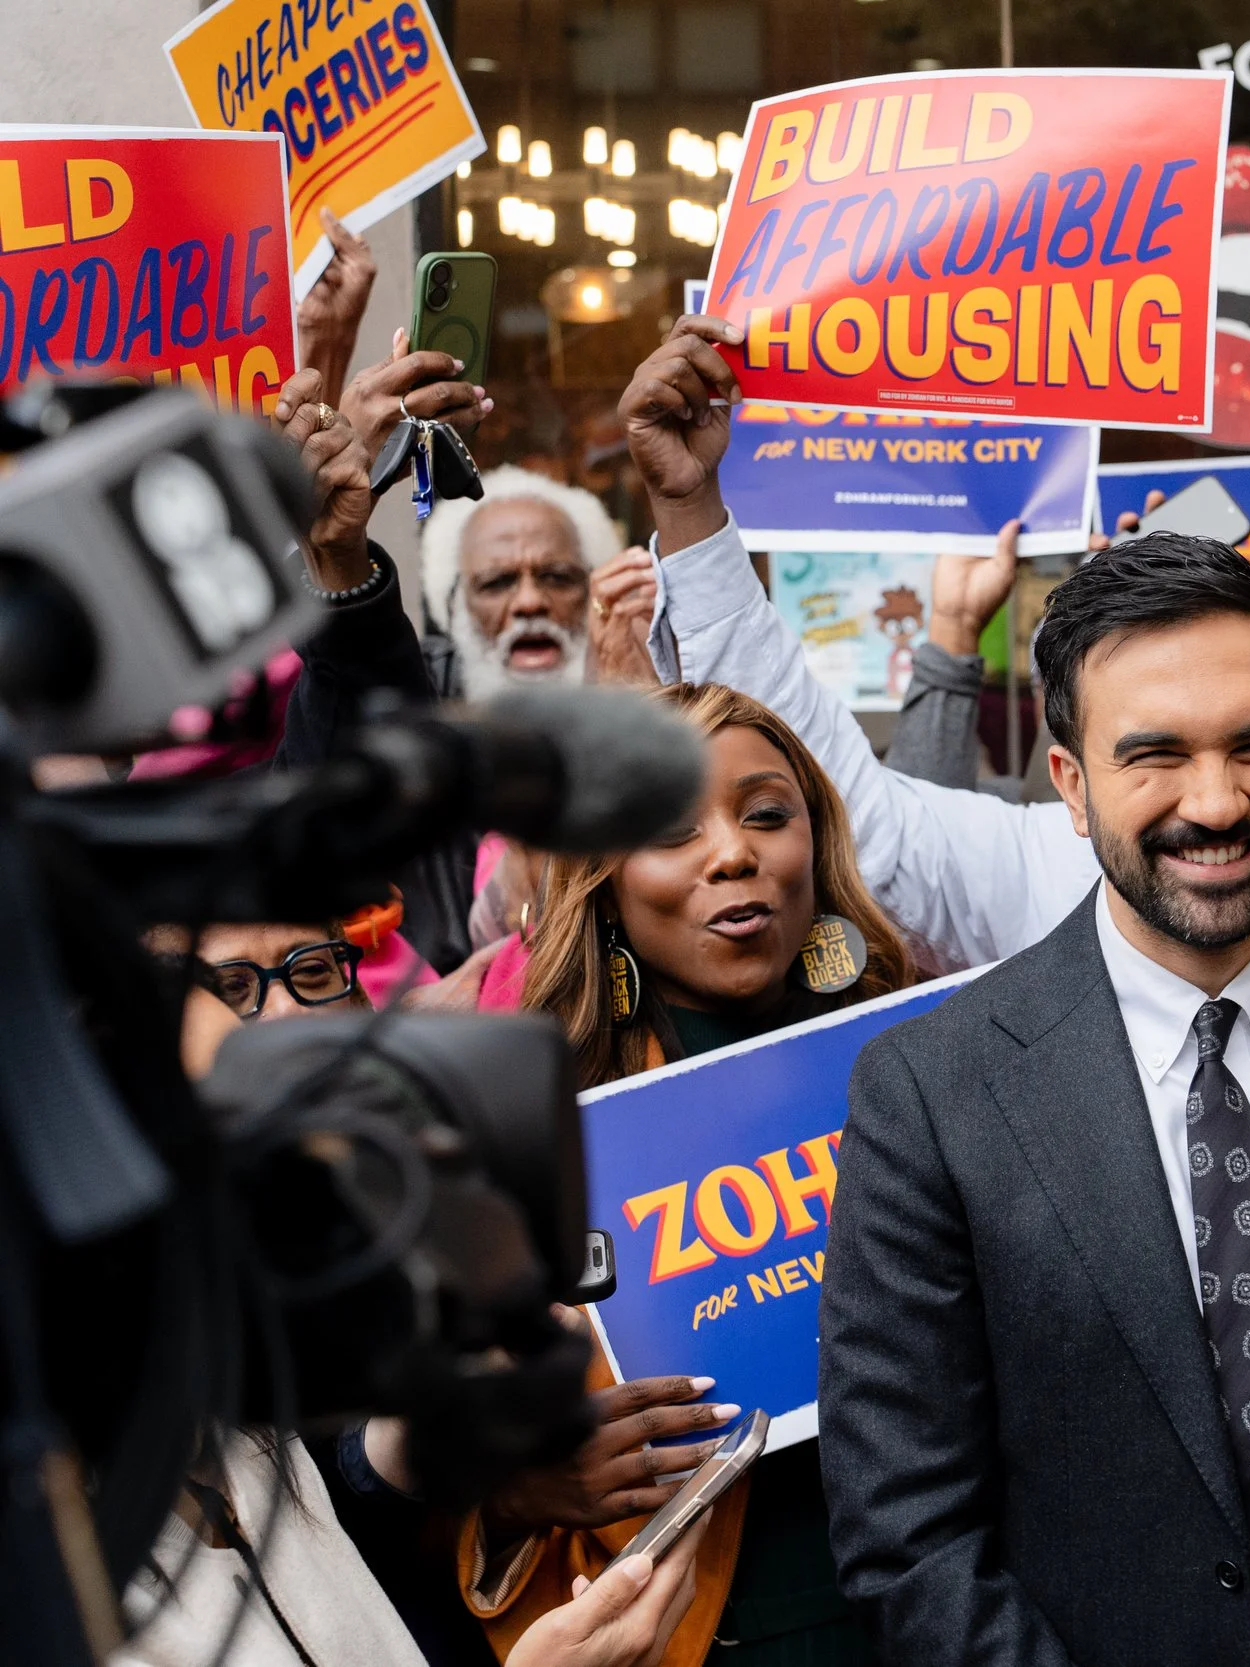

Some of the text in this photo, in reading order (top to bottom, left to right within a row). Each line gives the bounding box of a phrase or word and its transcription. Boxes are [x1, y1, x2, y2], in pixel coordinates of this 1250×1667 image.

[748, 92, 1033, 203] BUILD
[718, 158, 1198, 303] AFFORDABLE
[0, 225, 273, 384] RDABLE
[744, 273, 1182, 394] HOUSING
[754, 437, 1043, 463] FOR NEW YORK CITY
[802, 940, 852, 971] BLACK
[807, 957, 856, 987] QUEEN
[621, 1129, 844, 1286] ZOH
[693, 1284, 738, 1331] FOR
